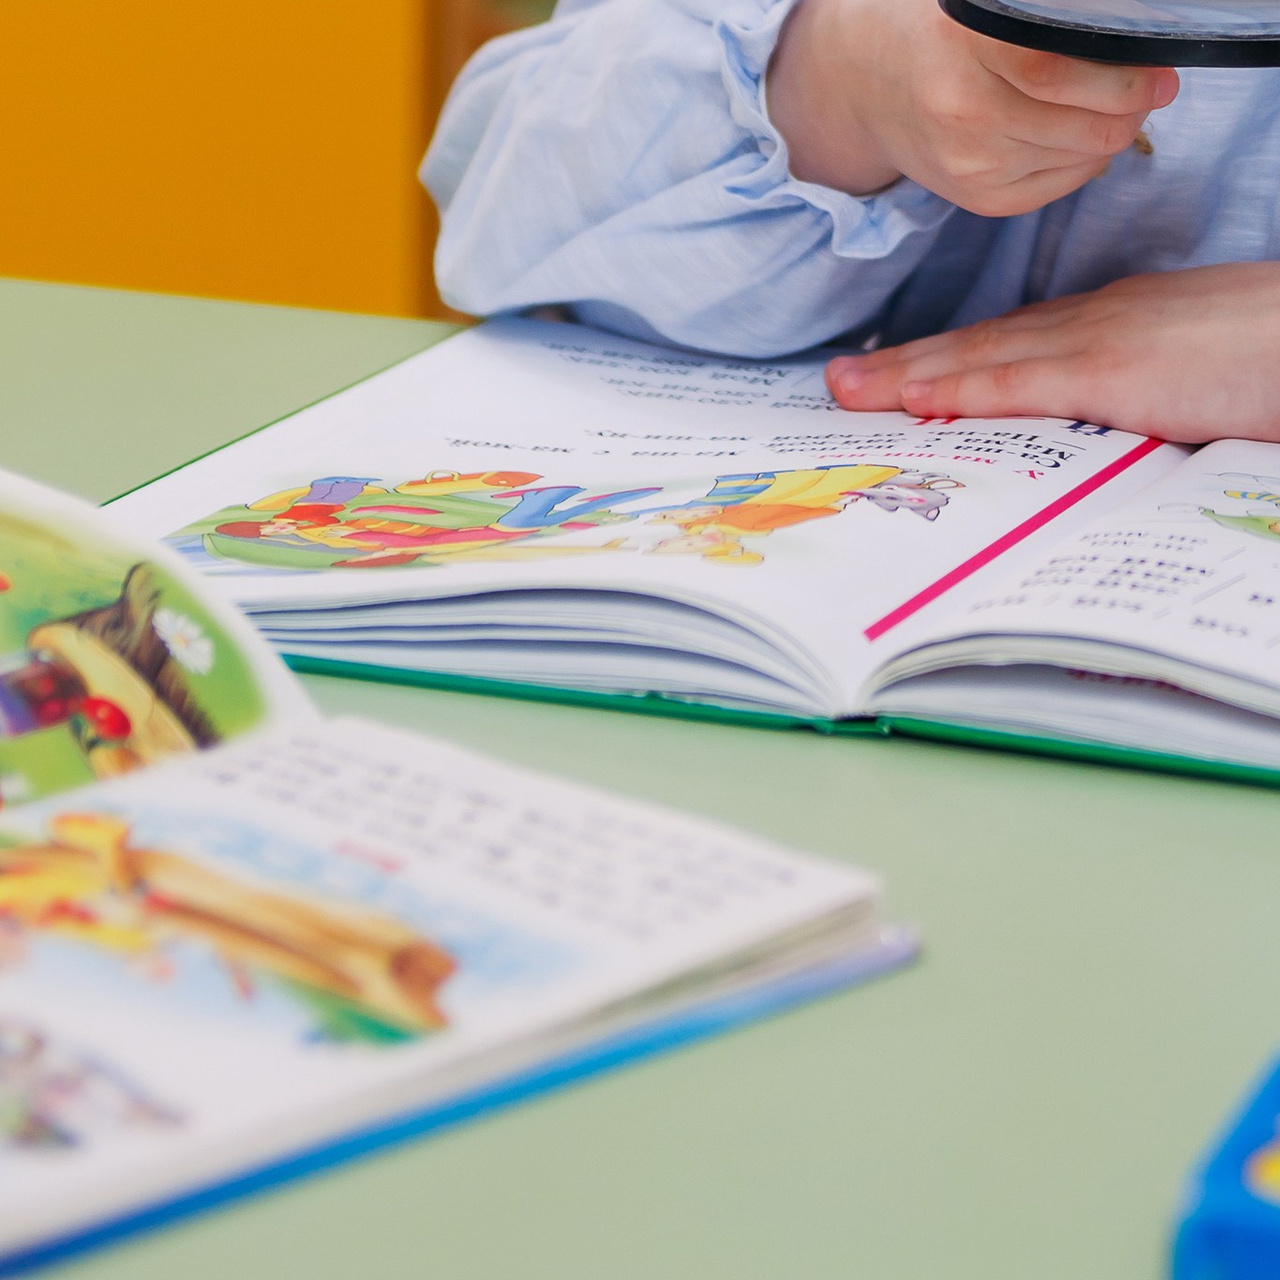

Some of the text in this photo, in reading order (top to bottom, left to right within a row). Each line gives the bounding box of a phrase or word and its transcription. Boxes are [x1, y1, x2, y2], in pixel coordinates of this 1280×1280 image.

[812, 452, 1000, 464] ма-ши-ны.
[954, 445, 1061, 468] Са-ша
[964, 438, 1078, 461] Ма-ма
